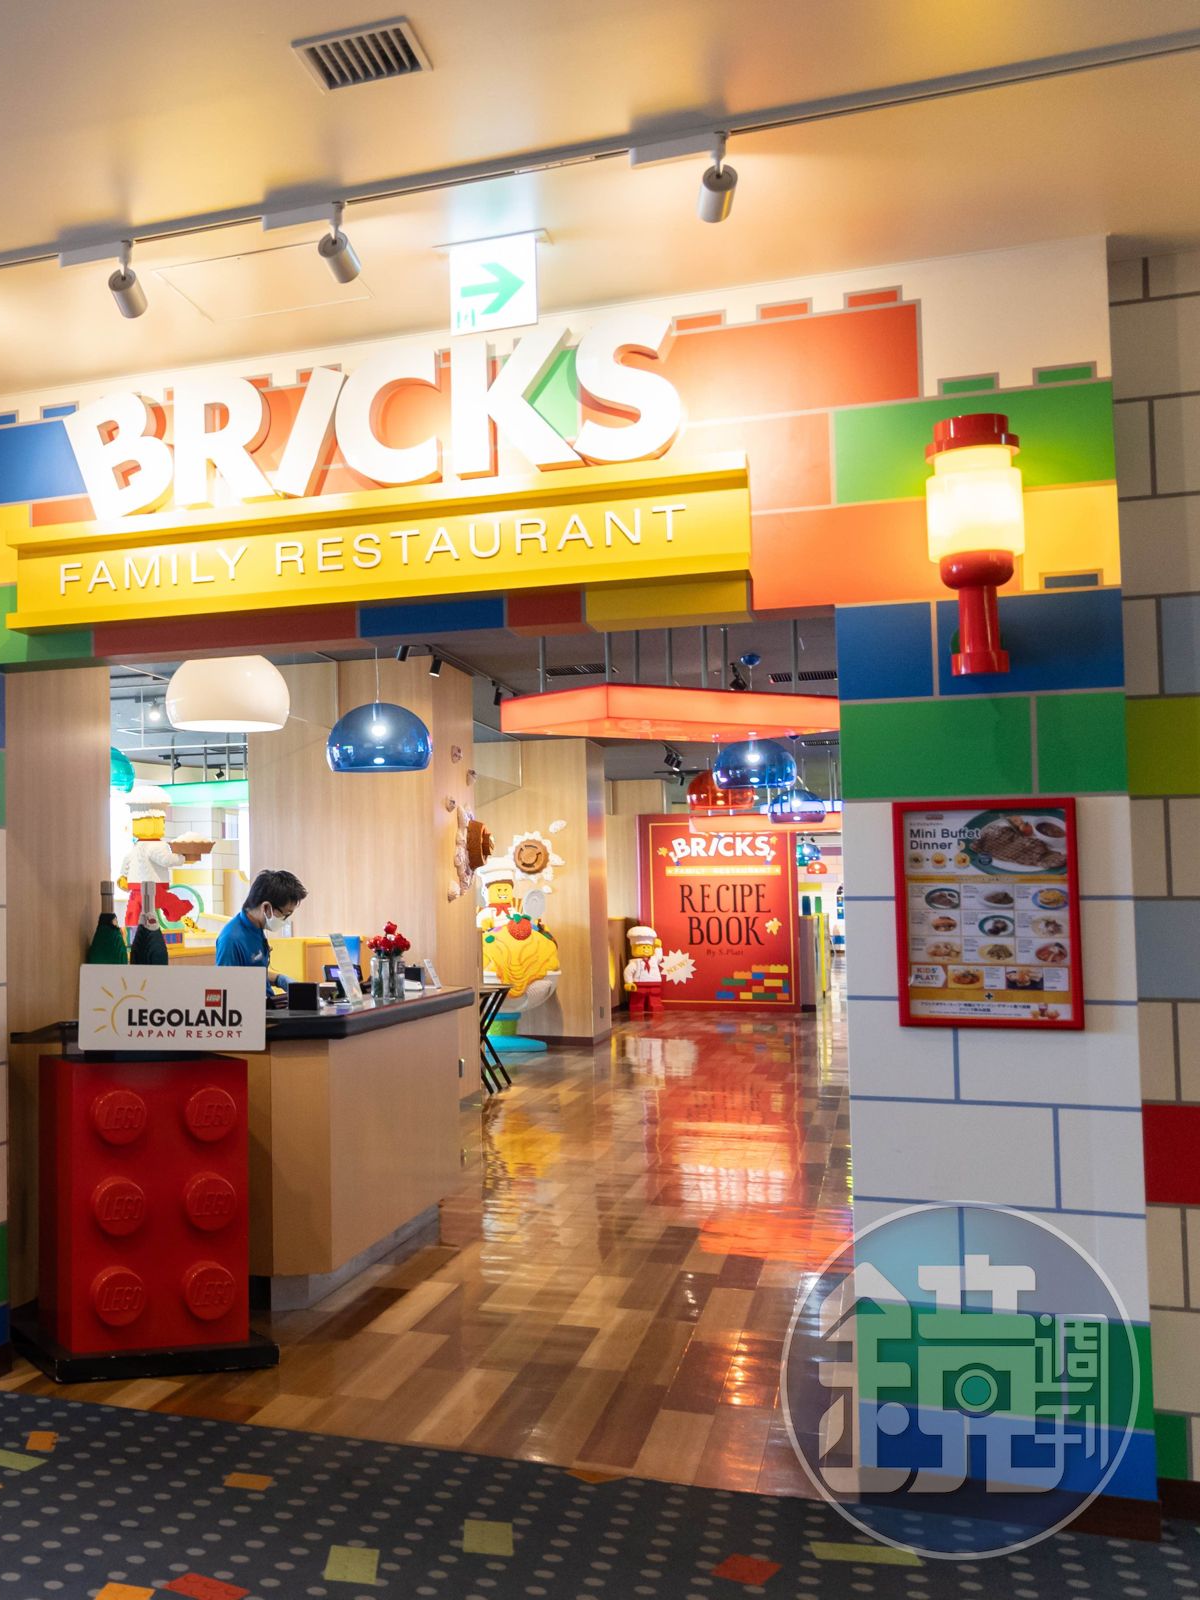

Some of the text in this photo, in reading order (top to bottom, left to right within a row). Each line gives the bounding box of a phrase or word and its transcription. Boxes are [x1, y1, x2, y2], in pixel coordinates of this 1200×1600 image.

[63, 318, 684, 519] BRICKS
[59, 504, 687, 595] FAMILY RESTAURANT
[909, 827, 981, 839] Mini Buffet
[909, 840, 952, 850] Dinner
[671, 836, 770, 859] BRICKS
[679, 883, 771, 914] RECIPE
[688, 916, 765, 946] BOOK
[127, 1008, 242, 1027] LEGOLAND
[127, 1029, 243, 1039] JAPAN RESORT
[102, 1105, 142, 1130] LEGO
[193, 1103, 231, 1127] LEGO
[102, 1195, 143, 1221] LEGO
[193, 1191, 232, 1217] LEGO
[102, 1286, 142, 1312] LEGO
[193, 1280, 233, 1306] LEGO
